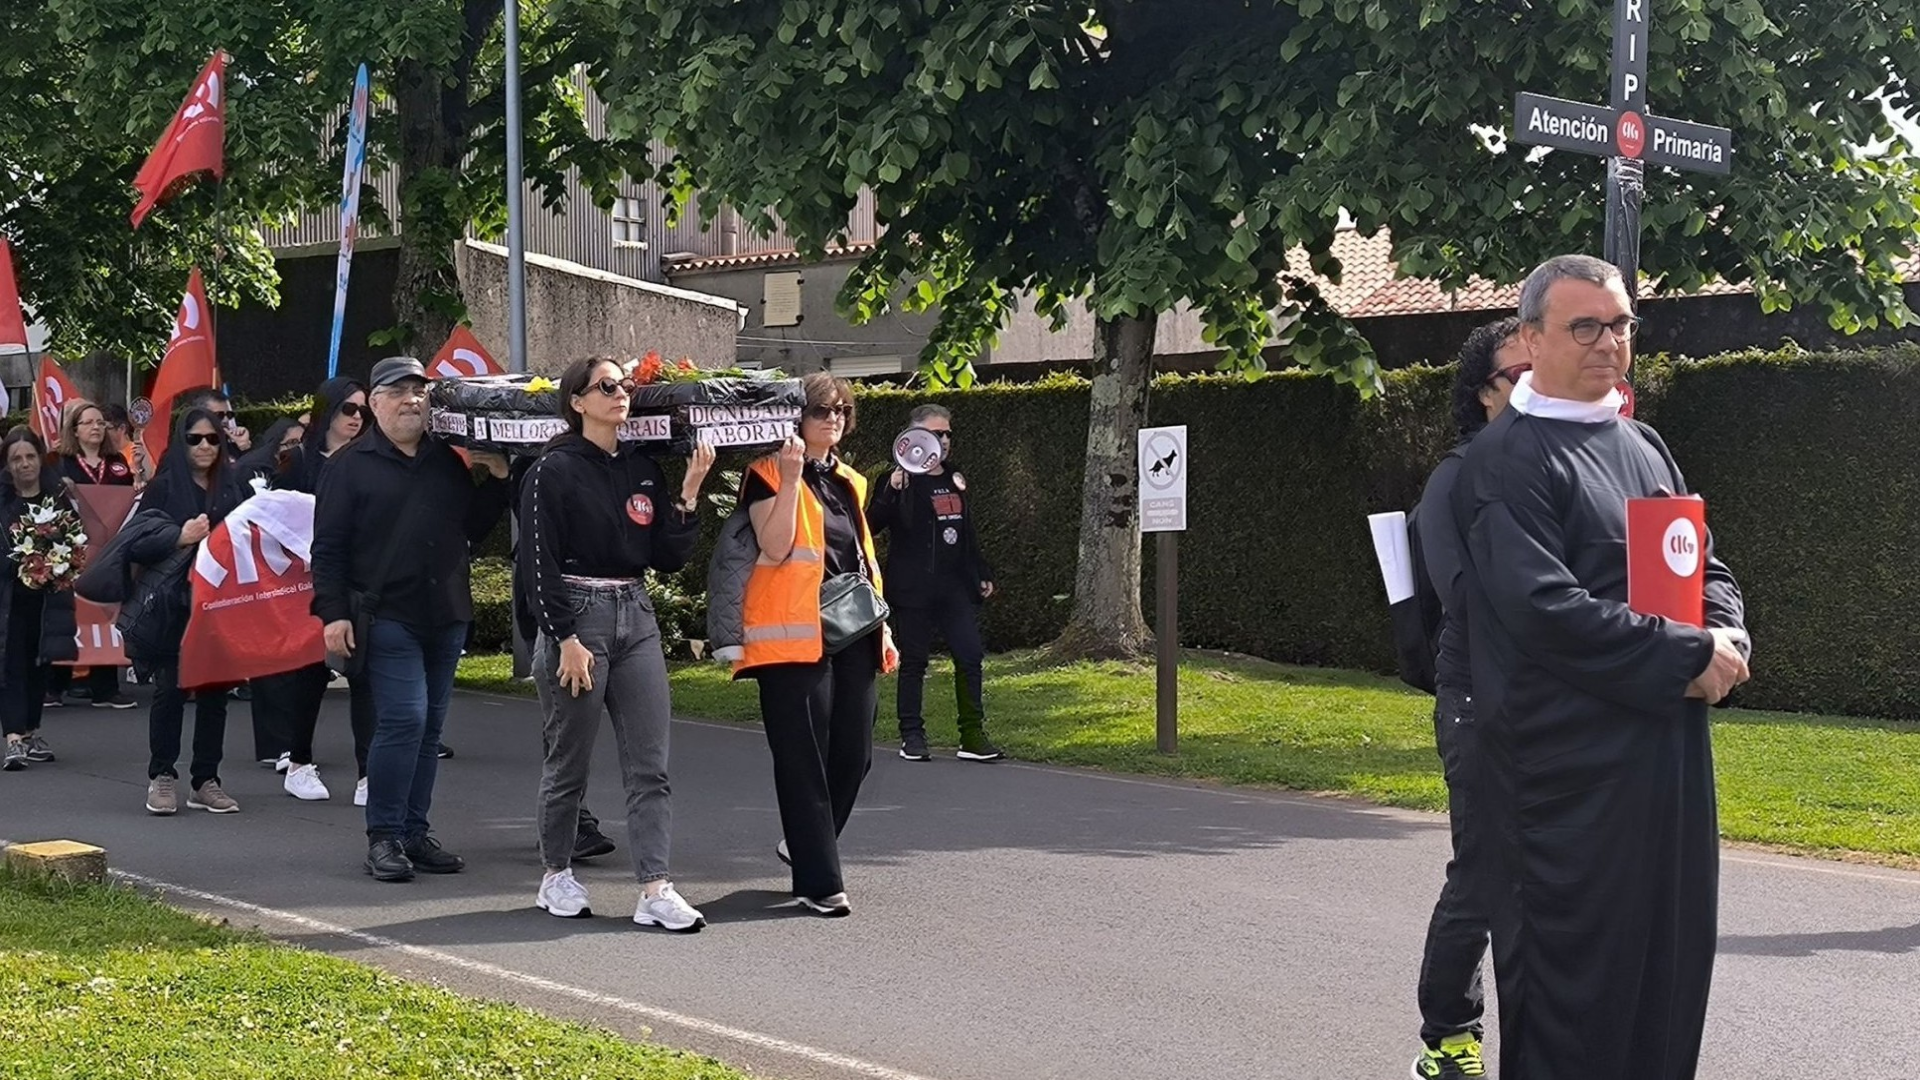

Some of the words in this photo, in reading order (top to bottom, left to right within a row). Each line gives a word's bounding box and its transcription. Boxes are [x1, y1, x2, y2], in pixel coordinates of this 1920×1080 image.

[1528, 106, 1608, 143] Atención
[1653, 128, 1722, 163] Primaria
[476, 421, 486, 437] A
[618, 419, 668, 438] ORAIS
